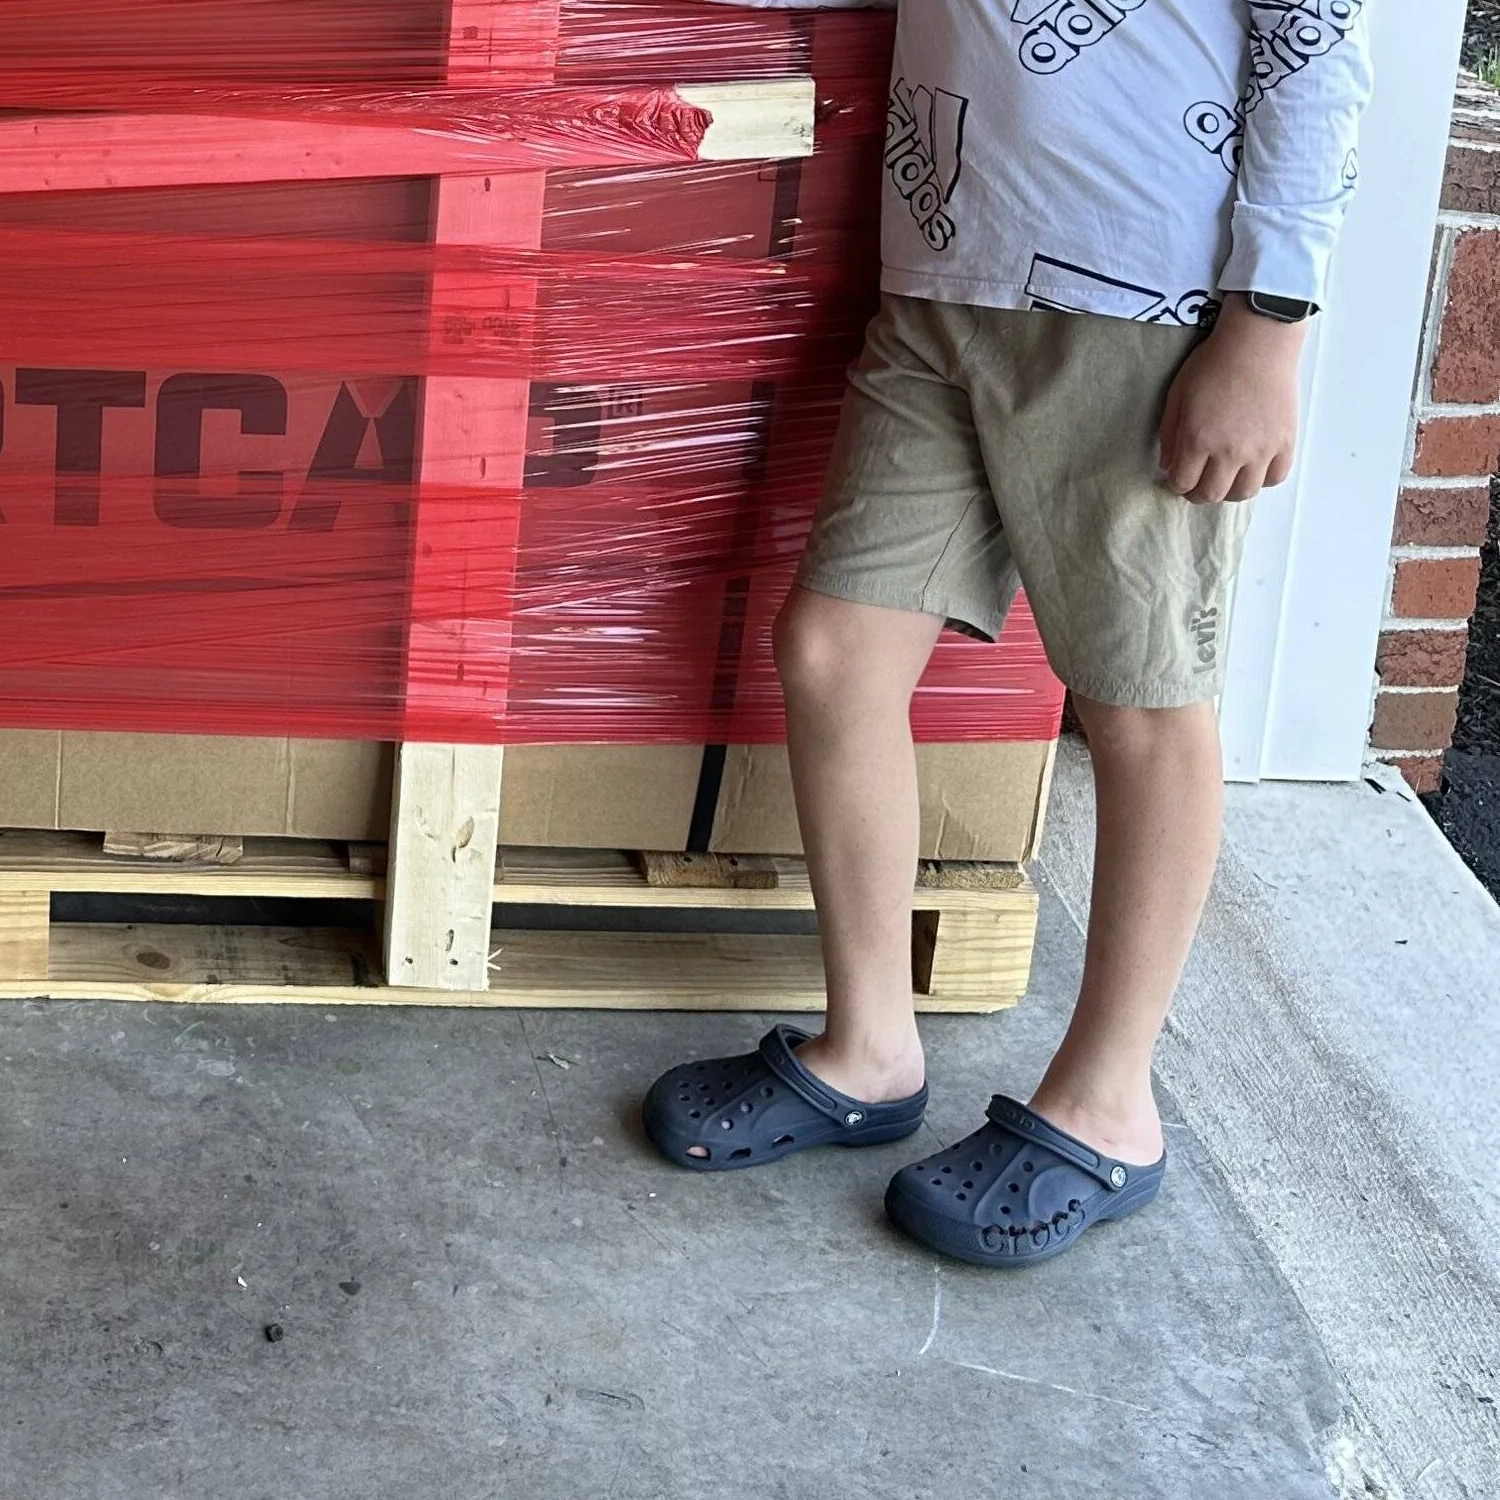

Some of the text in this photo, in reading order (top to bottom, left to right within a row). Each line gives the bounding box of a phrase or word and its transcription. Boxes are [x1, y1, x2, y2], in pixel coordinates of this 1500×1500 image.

[885, 98, 956, 251] didas
[1190, 607, 1218, 674] Levi's
[980, 1198, 1086, 1256] crocs
